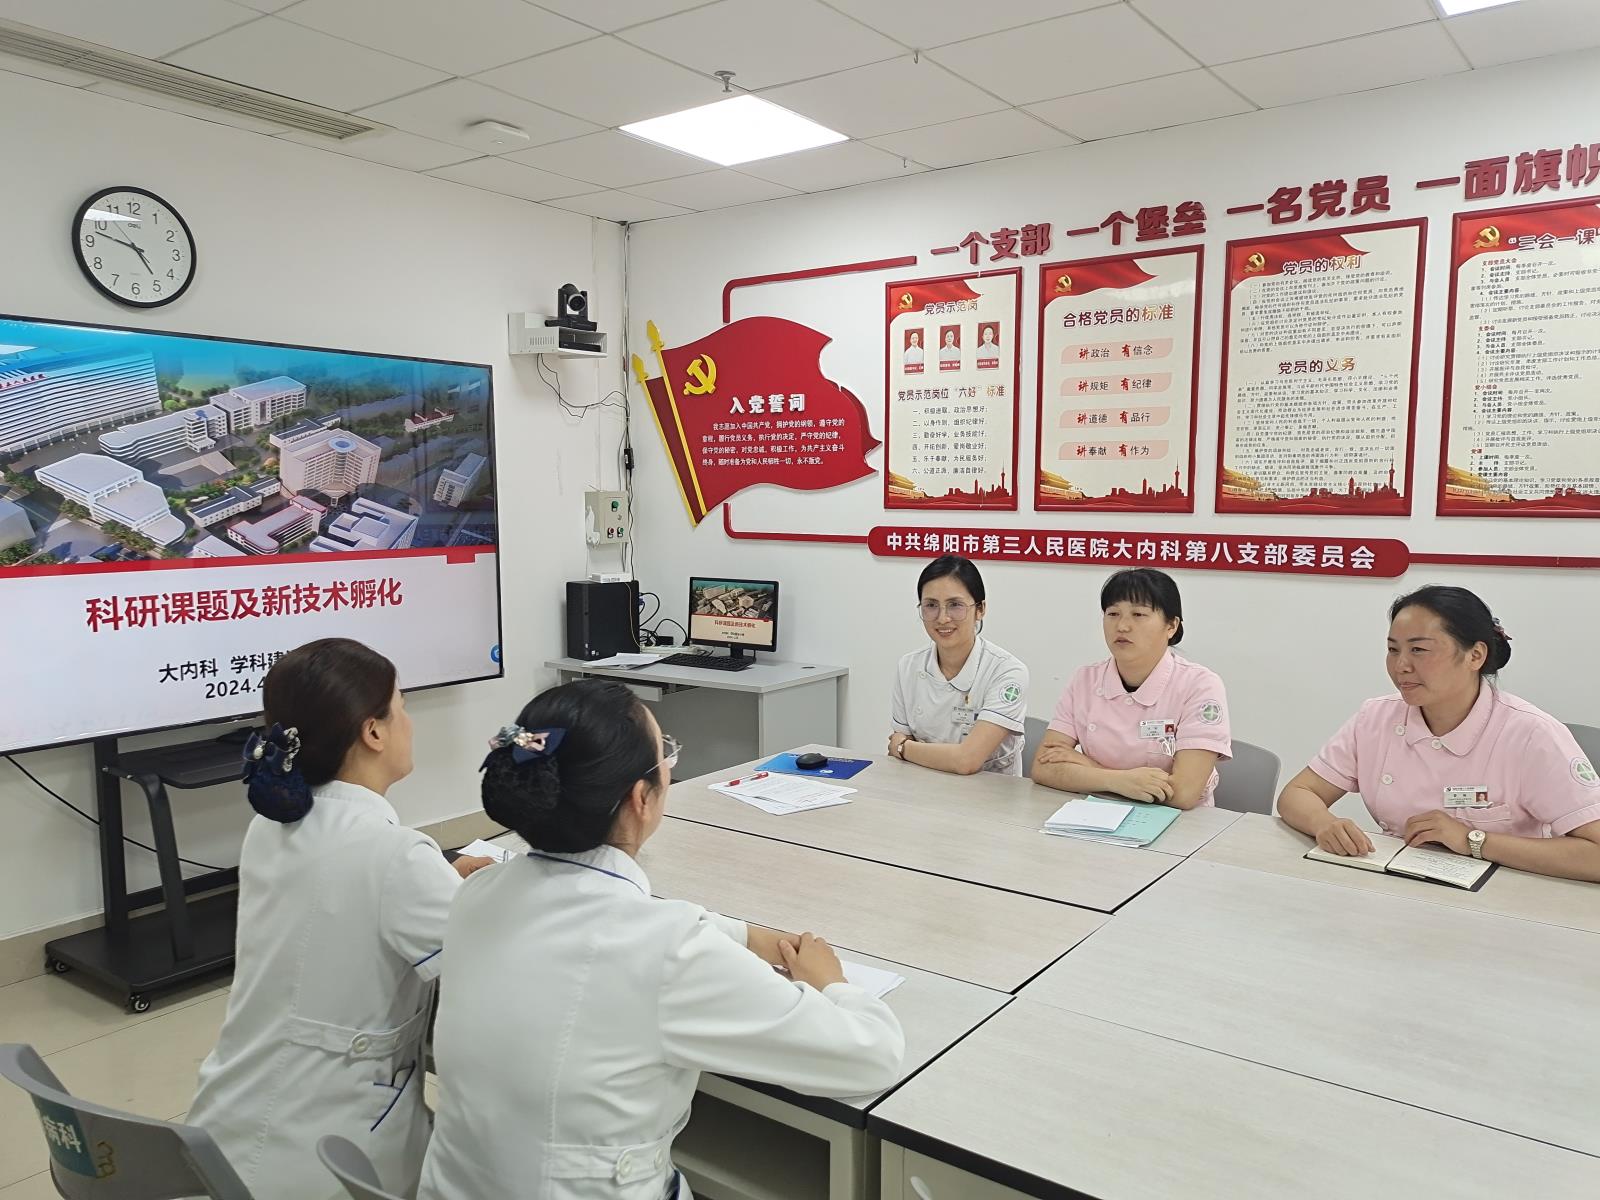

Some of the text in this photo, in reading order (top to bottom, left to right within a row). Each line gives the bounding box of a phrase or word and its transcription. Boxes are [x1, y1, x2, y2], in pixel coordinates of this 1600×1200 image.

[127, 202, 141, 215] 12
[931, 143, 1600, 264] 一个支部 一个堡垒 一名党员 一面旗帜
[152, 213, 158, 224] 1
[85, 235, 95, 247] 9
[166, 230, 175, 242] 2
[172, 249, 180, 261] 3
[94, 257, 102, 269] 8
[1283, 255, 1361, 276] 党员的权利
[112, 273, 120, 286] 7
[166, 268, 174, 280] 4
[131, 282, 140, 295] 6
[152, 280, 161, 292] 5
[925, 300, 978, 315] 党员示范岗
[1063, 304, 1174, 327] 合格党员的标准
[1078, 344, 1153, 360] 讲政治 有信念
[1278, 357, 1356, 375] 党员的义务
[1078, 377, 1152, 392] 讲规矩 有纪律
[730, 393, 806, 414] 入党誓词
[1077, 410, 1151, 424] 讲道德 有品行
[1076, 444, 1150, 457] 讲奉献 有作为
[886, 532, 1376, 570] 中共绵阳市第三人民医院大内科第八支部委员会
[86, 577, 403, 633] 科研课题及新技术孵化
[158, 650, 289, 683] 大内科 学科建
